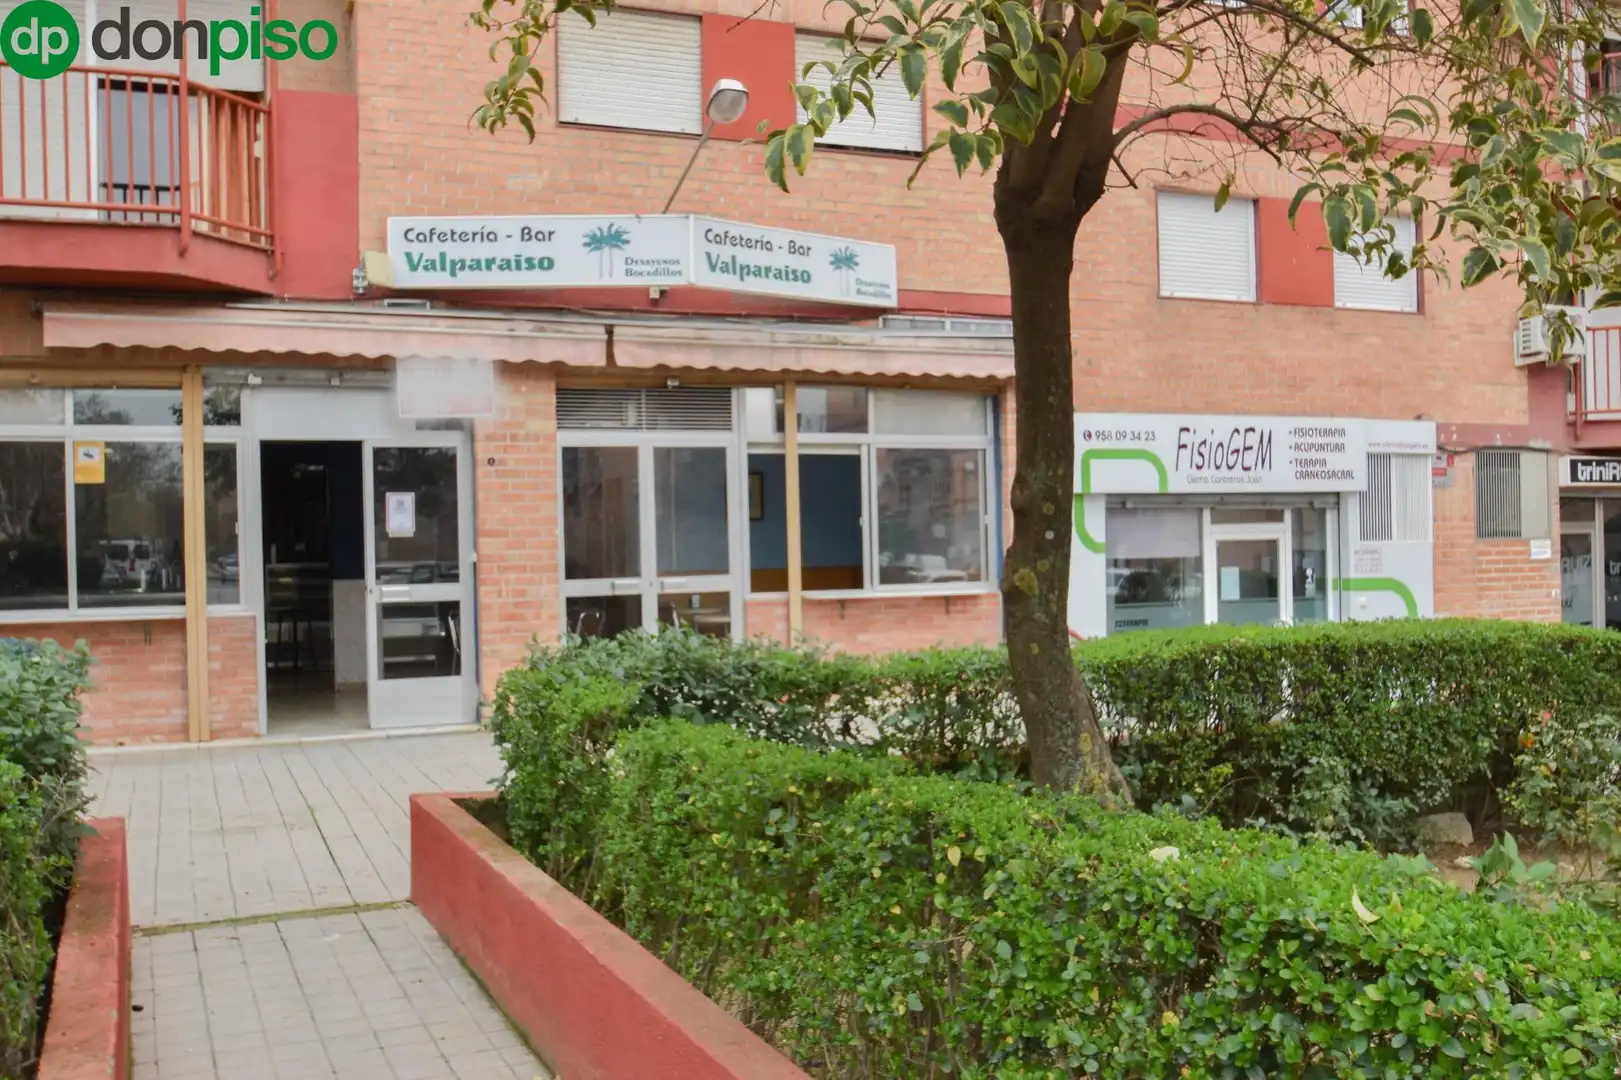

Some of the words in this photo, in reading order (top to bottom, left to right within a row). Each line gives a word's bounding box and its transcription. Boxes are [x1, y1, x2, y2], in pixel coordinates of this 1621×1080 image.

[403, 225, 498, 243] Cafetería
[520, 226, 556, 243] Bar
[704, 228, 773, 252] Cafetería
[788, 239, 812, 257] Bar
[1094, 430, 1113, 441] 958
[1115, 430, 1128, 441] 09
[1129, 430, 1142, 441] 34
[1143, 431, 1156, 441] 23
[1293, 427, 1346, 438] FISIOTERAPIA
[1175, 426, 1272, 472] FisioGEM
[1293, 442, 1346, 453] ACUPUNTURA
[1294, 458, 1327, 468] TERAPIA
[1294, 469, 1355, 480] CRANEOSACRAL
[1577, 461, 1621, 481] triniR
